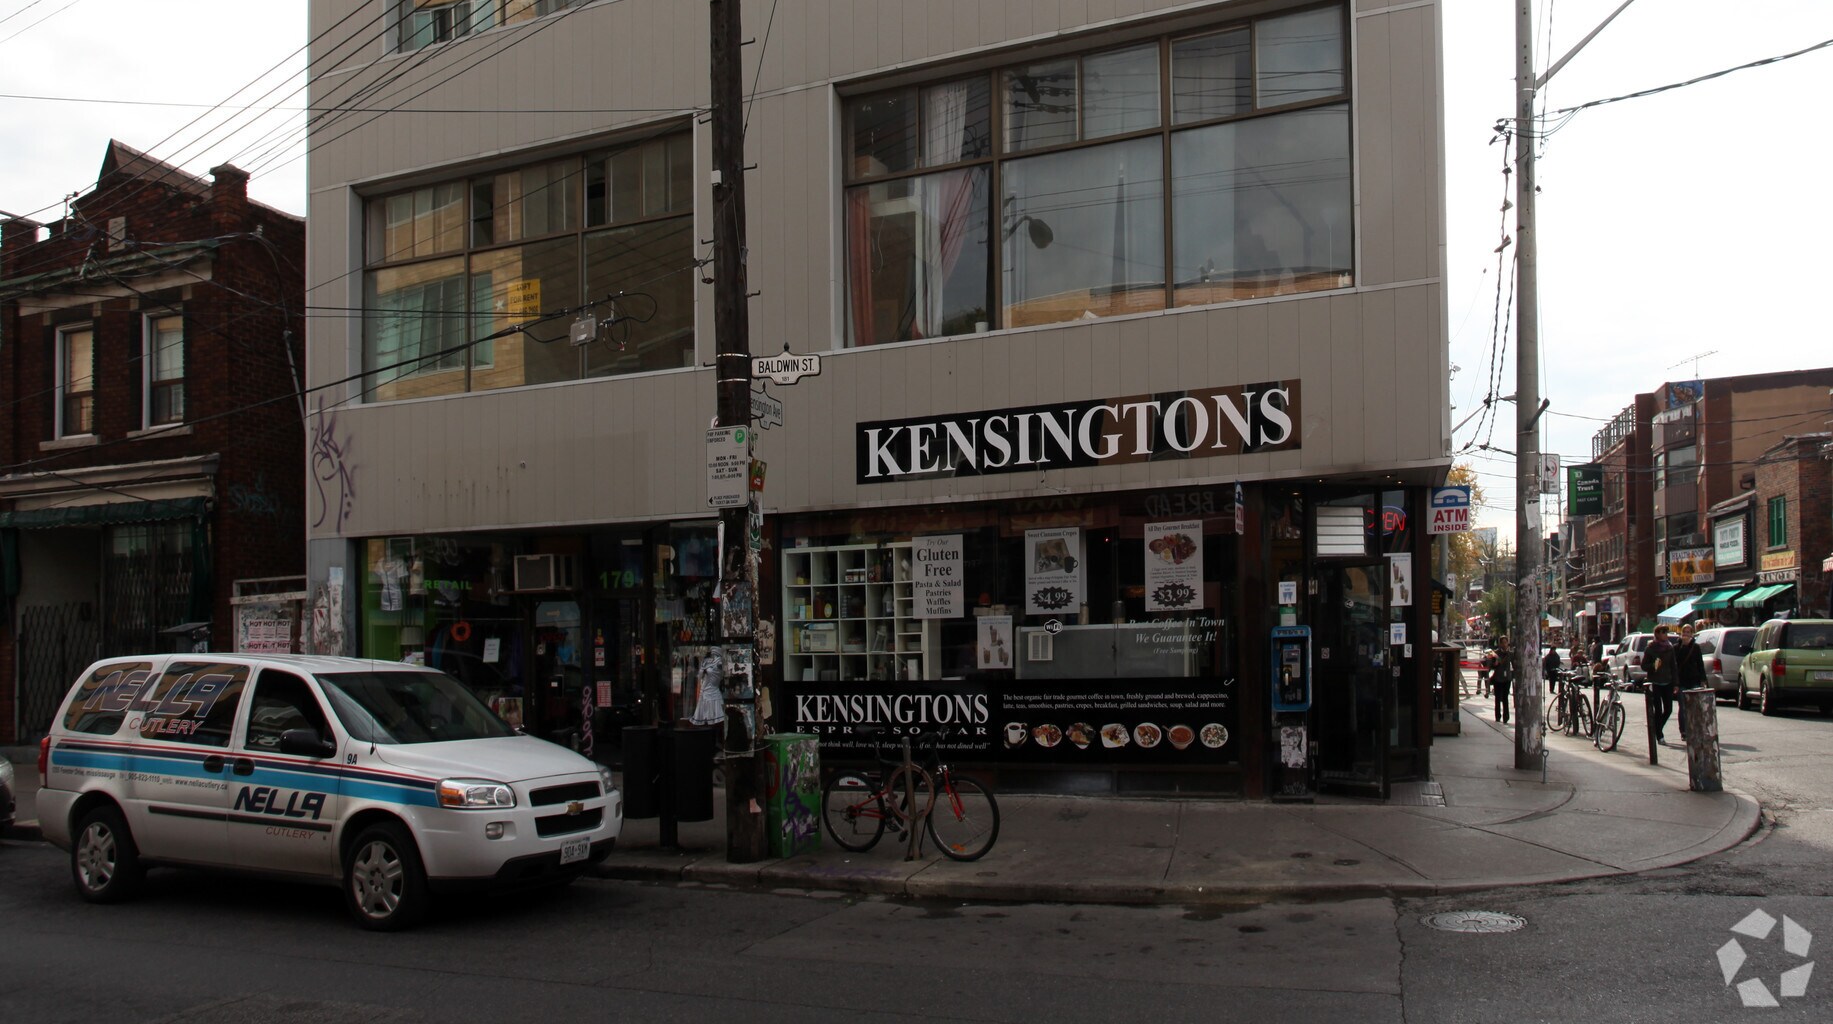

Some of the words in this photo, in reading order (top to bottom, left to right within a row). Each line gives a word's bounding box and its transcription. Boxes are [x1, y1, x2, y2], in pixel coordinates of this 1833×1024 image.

[522, 293, 538, 302] RENT
[758, 360, 800, 374] BALDWIN
[802, 358, 815, 372] ST.
[750, 398, 772, 416] ensington
[773, 404, 782, 420] Ave
[864, 387, 1293, 478] KENSINGTONS
[1433, 508, 1468, 523] ATM
[1434, 523, 1468, 532] INSIDE
[938, 538, 948, 546] Our
[917, 548, 959, 562] Gluten
[925, 564, 952, 577] Free
[423, 579, 473, 591] RETAIL
[600, 570, 635, 589] 179
[915, 580, 933, 588] Pasta
[943, 579, 961, 587] Salad
[925, 589, 951, 597] Pastries
[1038, 591, 1068, 605] $4.99
[1158, 588, 1190, 602] $3.99
[249, 620, 262, 628] HOT
[1185, 617, 1195, 628] In
[1199, 616, 1225, 627] Town
[1136, 633, 1149, 644] We
[1152, 632, 1203, 643] Guarantee
[1205, 630, 1218, 642] It!
[1170, 647, 1199, 655] Sampng)
[82, 669, 235, 718] NELLA
[795, 693, 989, 724] KENSINGTONS
[129, 717, 204, 735] CUTLERY
[796, 726, 921, 734] ESPRSO
[957, 742, 974, 750] dined
[233, 785, 327, 820] NELLA
[265, 826, 316, 840] CUTLERY
